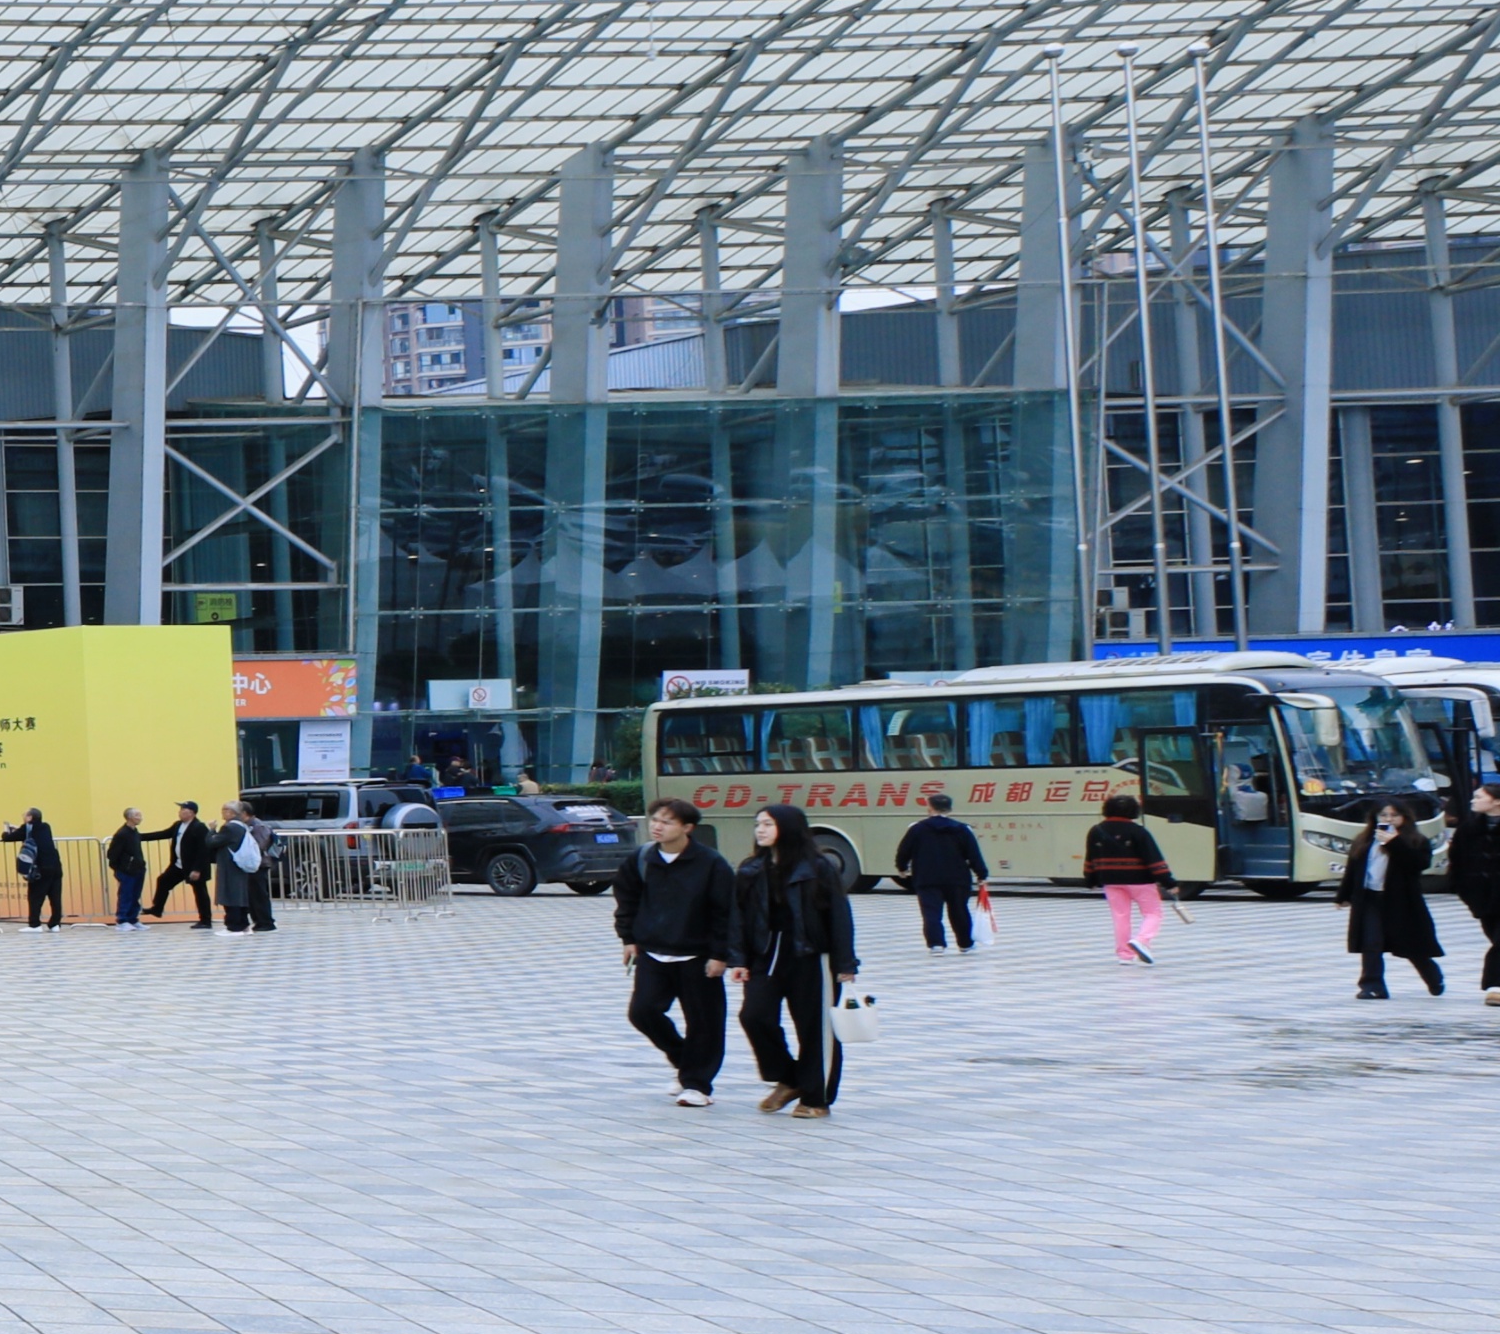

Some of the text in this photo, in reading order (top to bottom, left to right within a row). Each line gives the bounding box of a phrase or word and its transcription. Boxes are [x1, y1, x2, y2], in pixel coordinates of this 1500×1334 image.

[693, 780, 947, 809] CD-TRANS
[968, 780, 1110, 803] 成都运总
